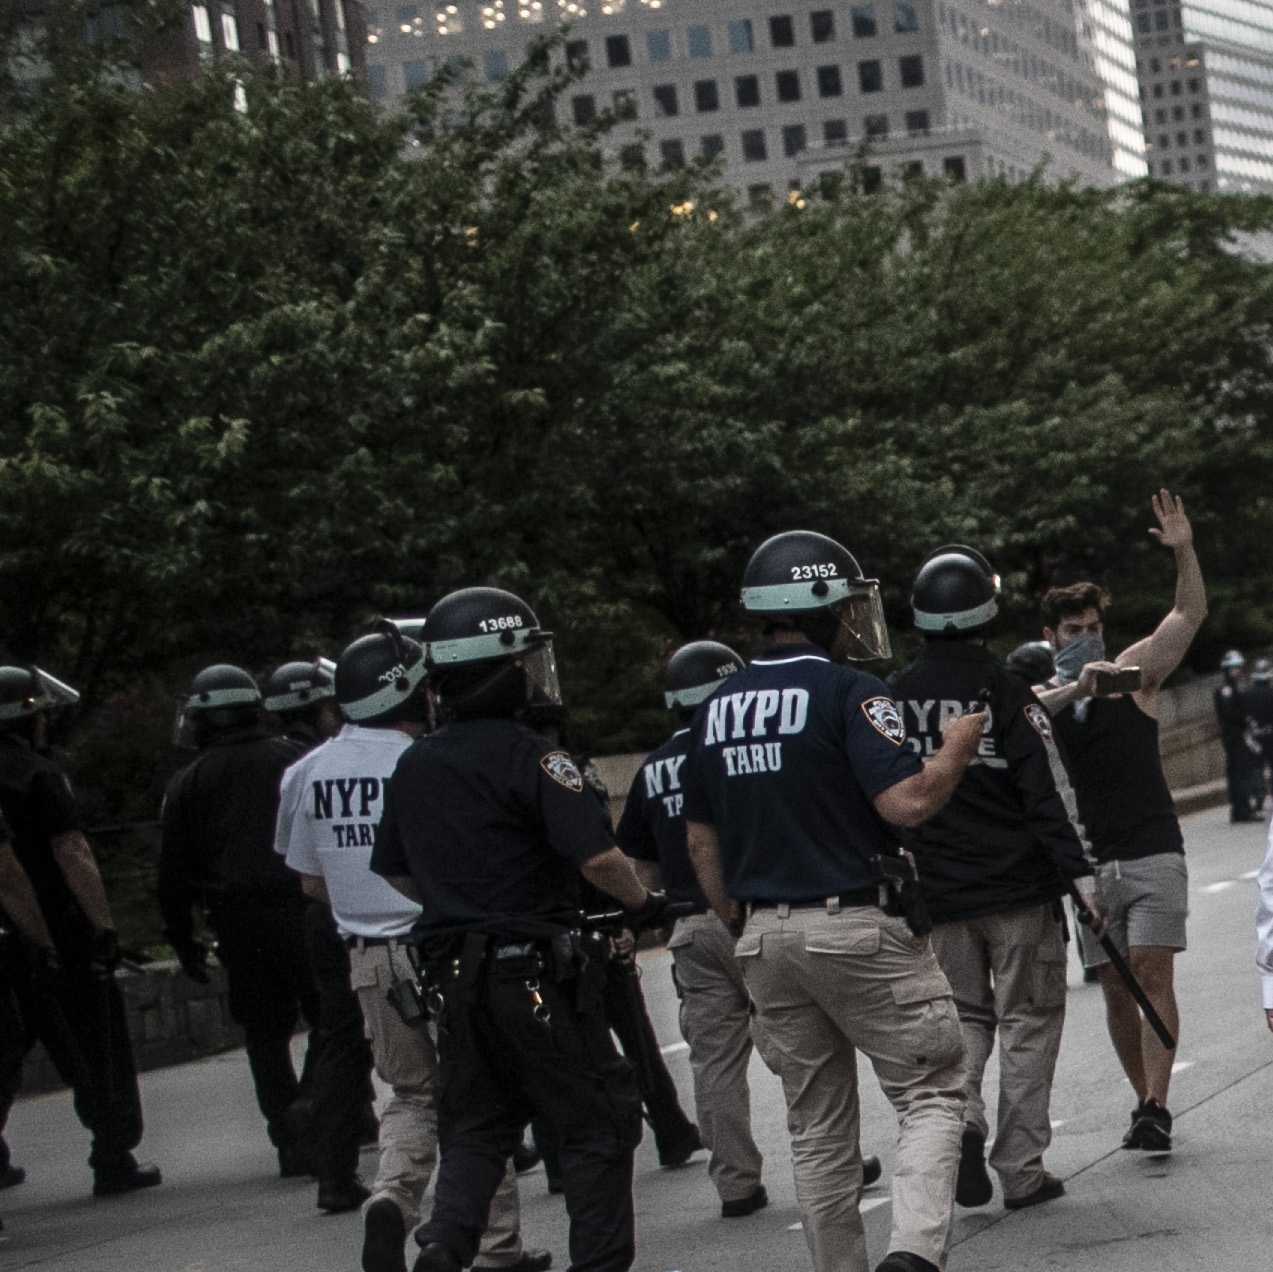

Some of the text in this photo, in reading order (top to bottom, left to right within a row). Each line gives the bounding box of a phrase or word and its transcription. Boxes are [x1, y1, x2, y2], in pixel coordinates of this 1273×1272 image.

[790, 562, 839, 580] 23152
[704, 688, 809, 746] NYPD
[722, 742, 782, 776] TARU
[312, 777, 391, 820] NYP
